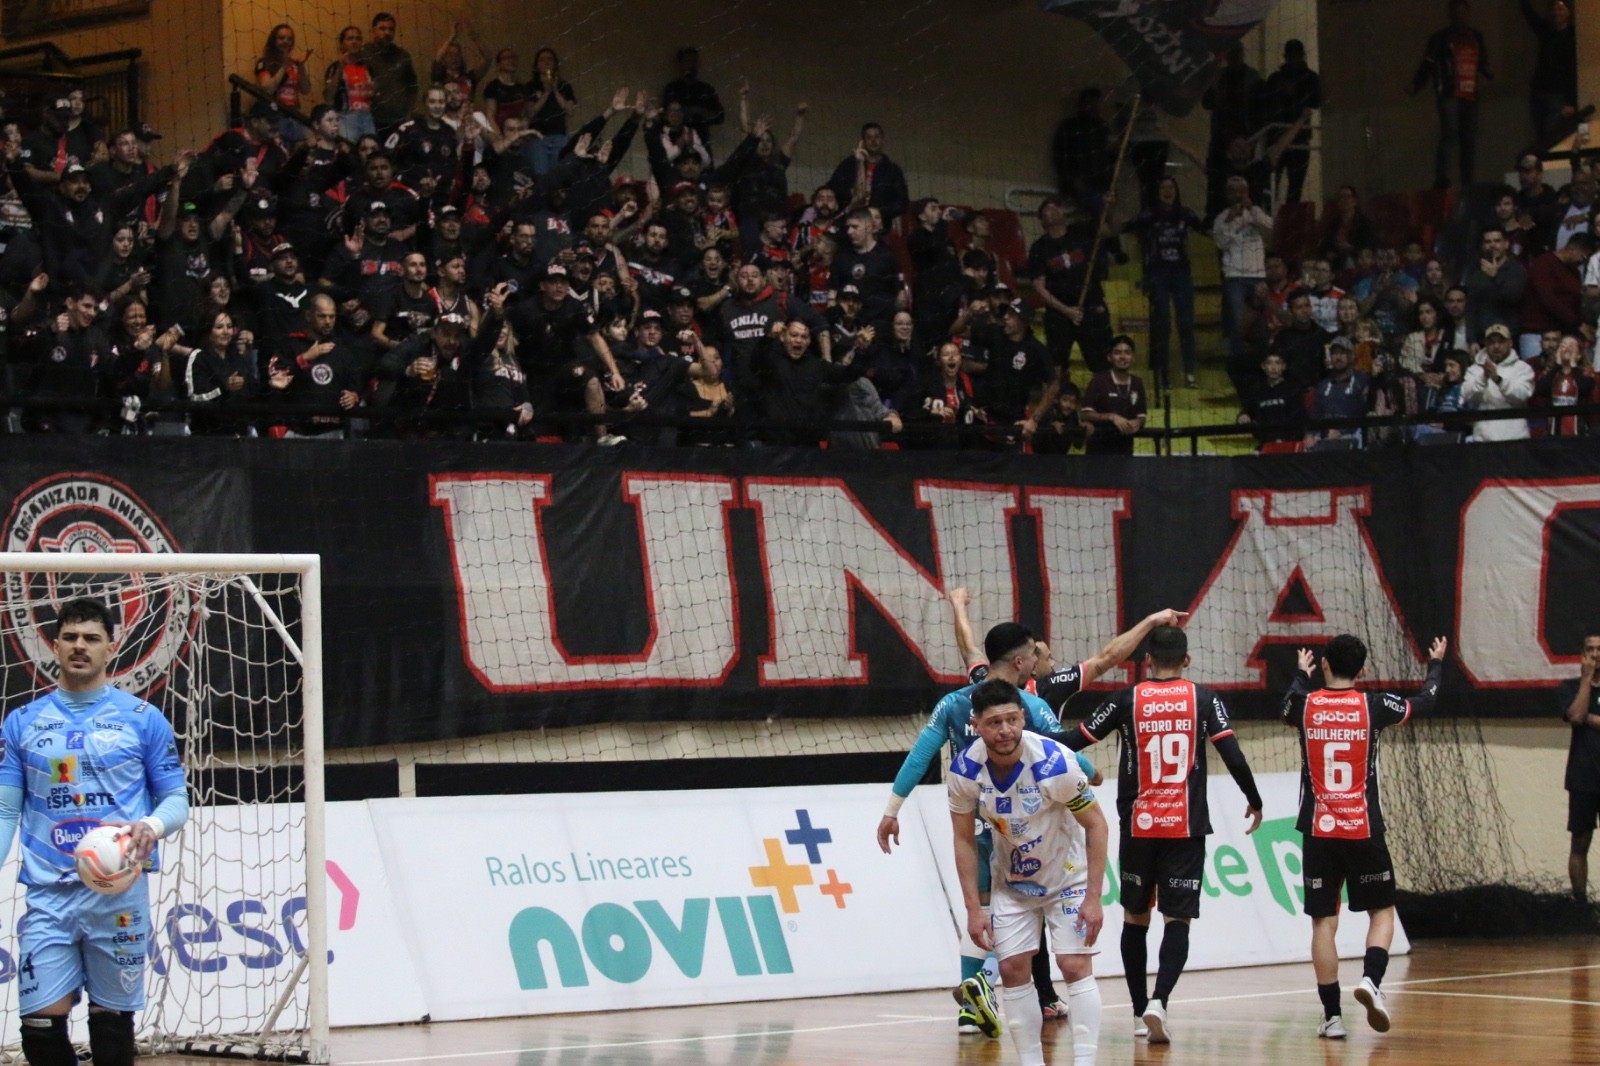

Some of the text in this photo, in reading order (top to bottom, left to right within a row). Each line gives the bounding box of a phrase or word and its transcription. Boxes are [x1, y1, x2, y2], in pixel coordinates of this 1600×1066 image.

[14, 486, 100, 542] ORGANIZADA
[108, 493, 155, 540] UNIÃO
[1157, 685, 1189, 694] KRONA
[1088, 702, 1118, 730] VIQUA
[1143, 700, 1188, 717] global
[1138, 718, 1192, 733] PEDRO REI
[1313, 710, 1361, 725] global
[1307, 727, 1367, 741] GUILHERME
[1144, 732, 1190, 784] 19
[1323, 741, 1353, 792] 6
[1154, 815, 1183, 823] DALTON
[1336, 818, 1364, 826] DALTON
[485, 851, 693, 887] Ralos Lineares
